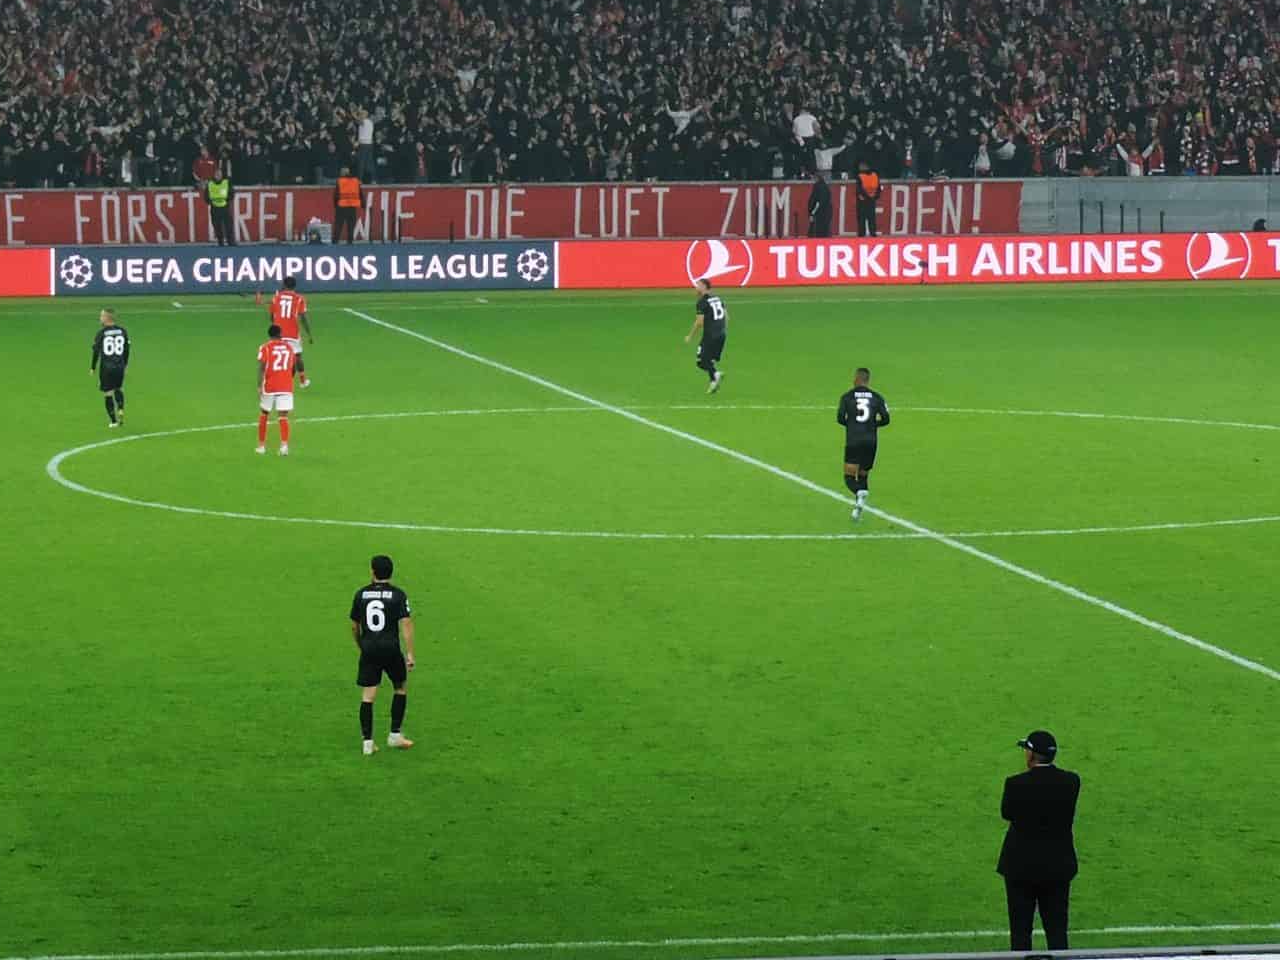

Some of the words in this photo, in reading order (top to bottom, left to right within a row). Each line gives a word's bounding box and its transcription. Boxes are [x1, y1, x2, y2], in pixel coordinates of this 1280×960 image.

[74, 191, 294, 244] FÖRSTREI
[465, 188, 525, 239] DIE
[574, 187, 669, 238] LUFT
[720, 186, 790, 239] ZUM
[101, 258, 184, 283] UEFA
[192, 255, 378, 282] CHAMPIONS
[391, 252, 508, 280] LEAGUE
[769, 243, 958, 279] TURKISH
[971, 239, 1163, 276] AIRLINES
[279, 300, 293, 319] 11
[103, 336, 125, 356] 68
[272, 350, 290, 372] 27
[855, 398, 870, 422] 3
[366, 599, 385, 632] 6
